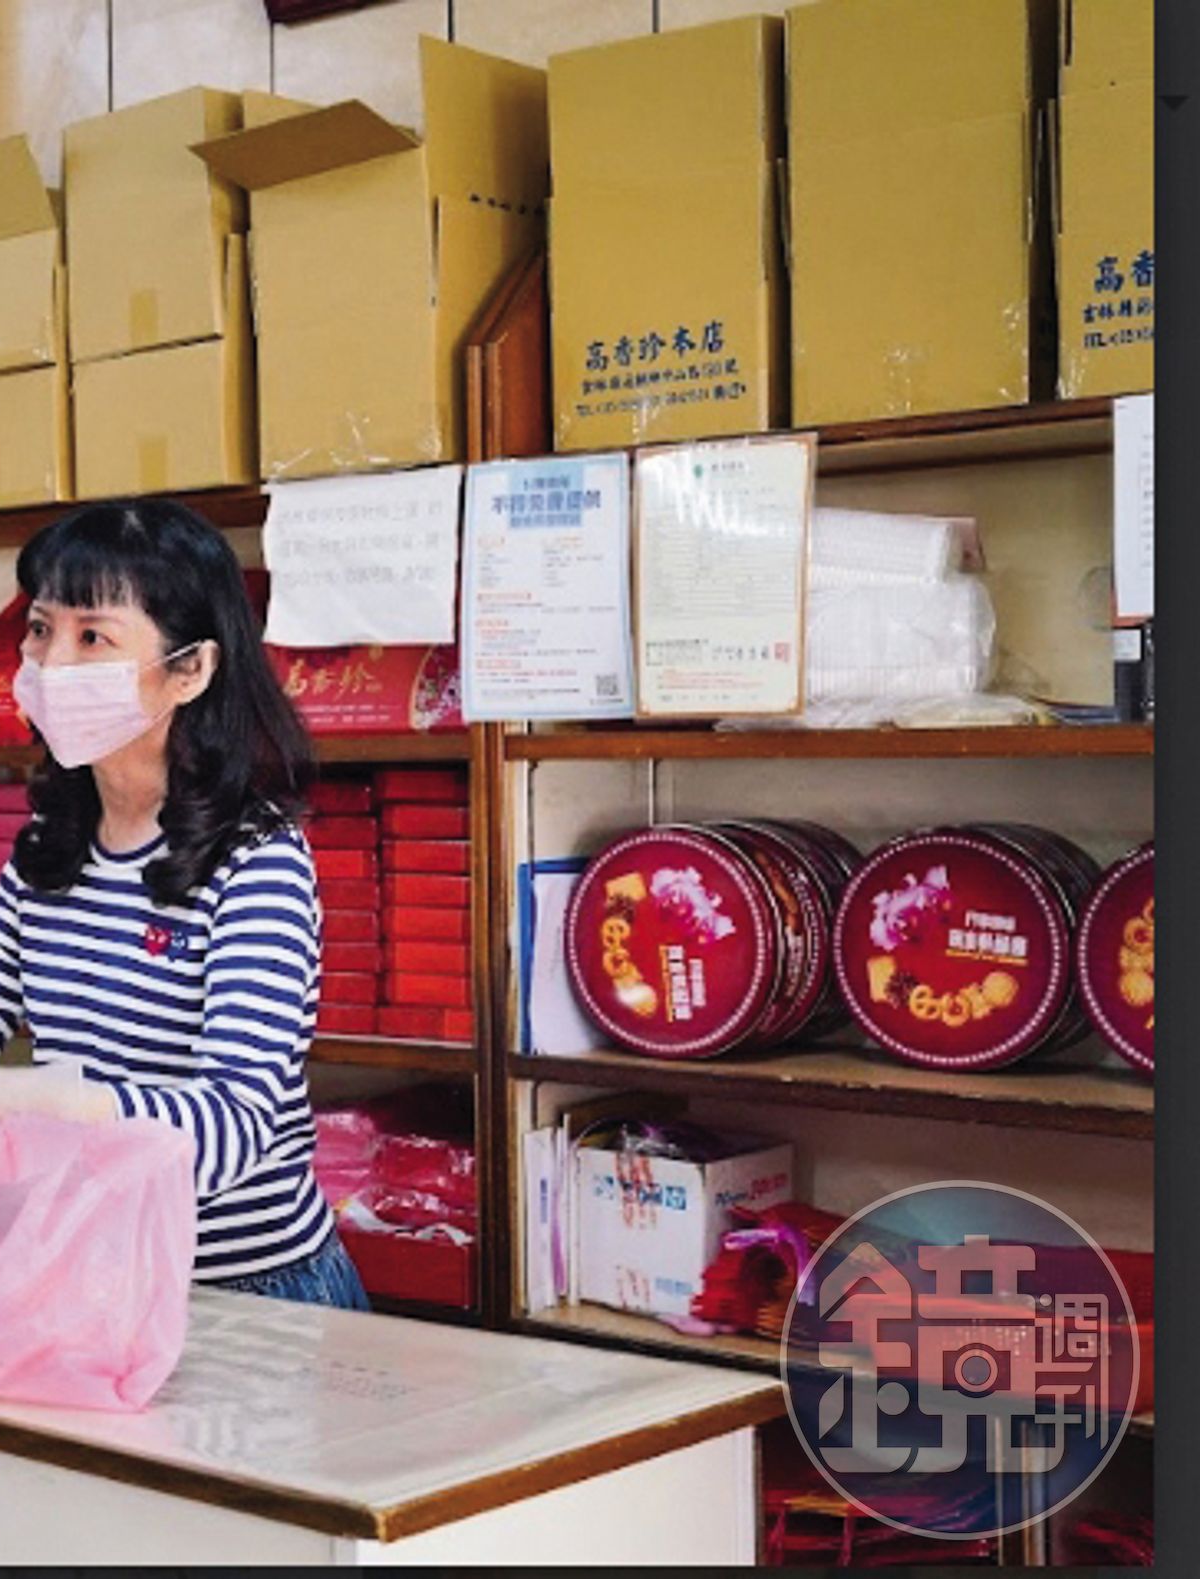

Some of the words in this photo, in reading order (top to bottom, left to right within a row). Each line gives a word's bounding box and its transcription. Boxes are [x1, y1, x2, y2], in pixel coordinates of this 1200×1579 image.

[586, 320, 724, 370] 高香珍本店
